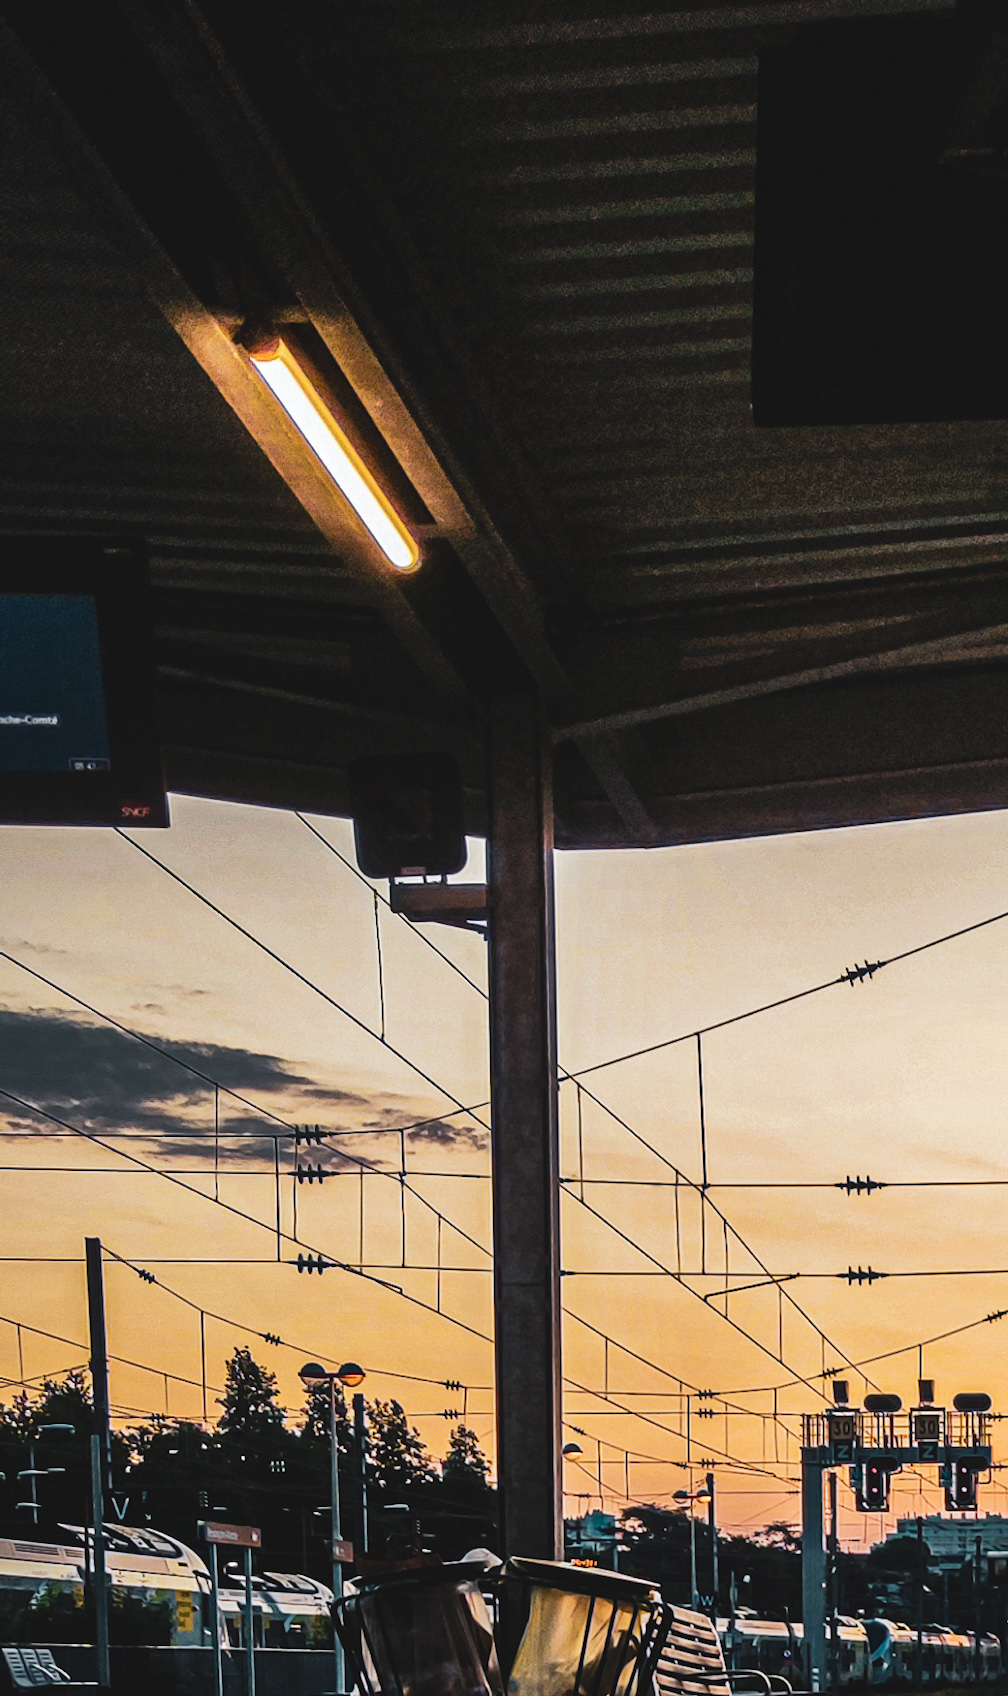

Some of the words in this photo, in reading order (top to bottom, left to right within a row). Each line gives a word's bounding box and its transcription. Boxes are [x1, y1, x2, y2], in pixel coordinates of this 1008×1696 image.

[121, 806, 151, 817] SNCF
[833, 1421, 850, 1436] 30
[919, 1420, 936, 1435] 30
[837, 1445, 849, 1459] Z
[922, 1445, 934, 1459] Z
[111, 1496, 130, 1520] V
[700, 1595, 714, 1606] W
